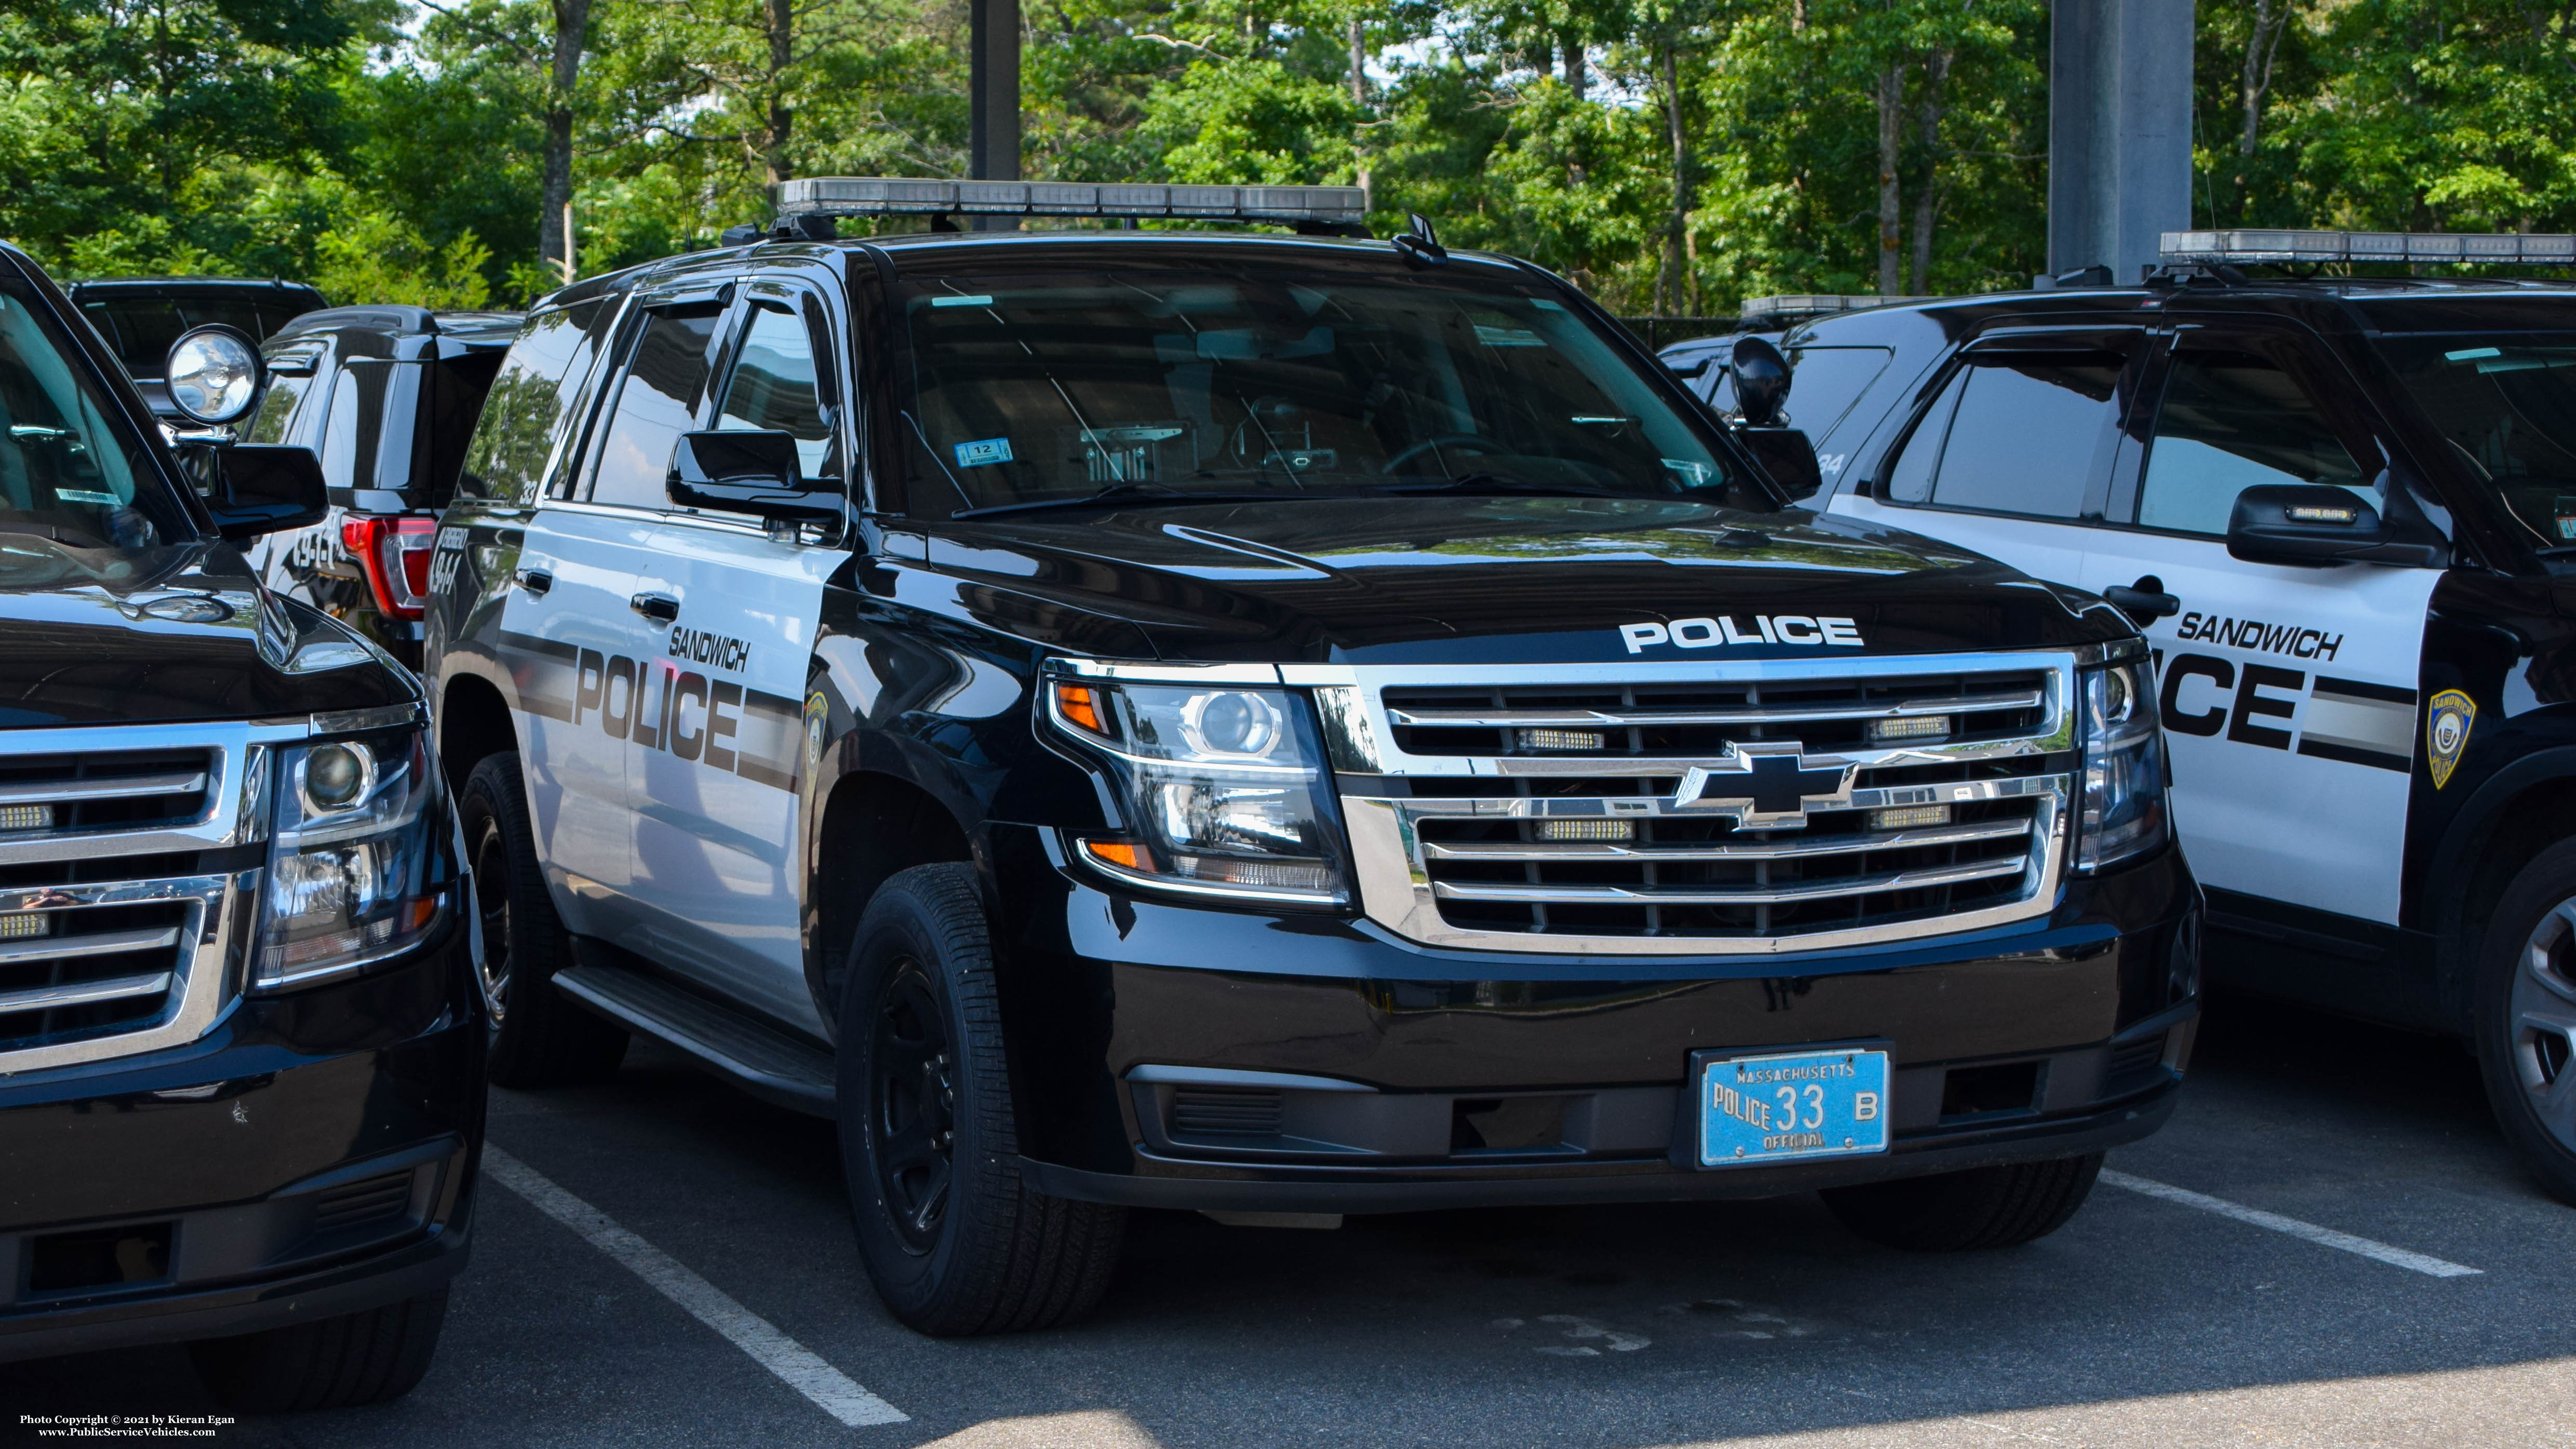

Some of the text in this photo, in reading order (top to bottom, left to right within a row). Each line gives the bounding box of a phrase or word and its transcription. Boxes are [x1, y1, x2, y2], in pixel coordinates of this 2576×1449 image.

[974, 445, 991, 453] 12
[520, 480, 538, 504] 33
[669, 626, 750, 673] SANDWICH
[1619, 615, 1864, 654] POLICE
[2177, 611, 2343, 662] SANDWICH
[574, 648, 743, 773] POLICE
[2152, 648, 2305, 751] CE
[2434, 695, 2472, 717] SANDWICH
[1737, 1064, 1855, 1084] MASSACHUSETTS
[1714, 1082, 1879, 1132] POLICE 33 B
[1764, 1132, 1825, 1150] OFFICIAL
